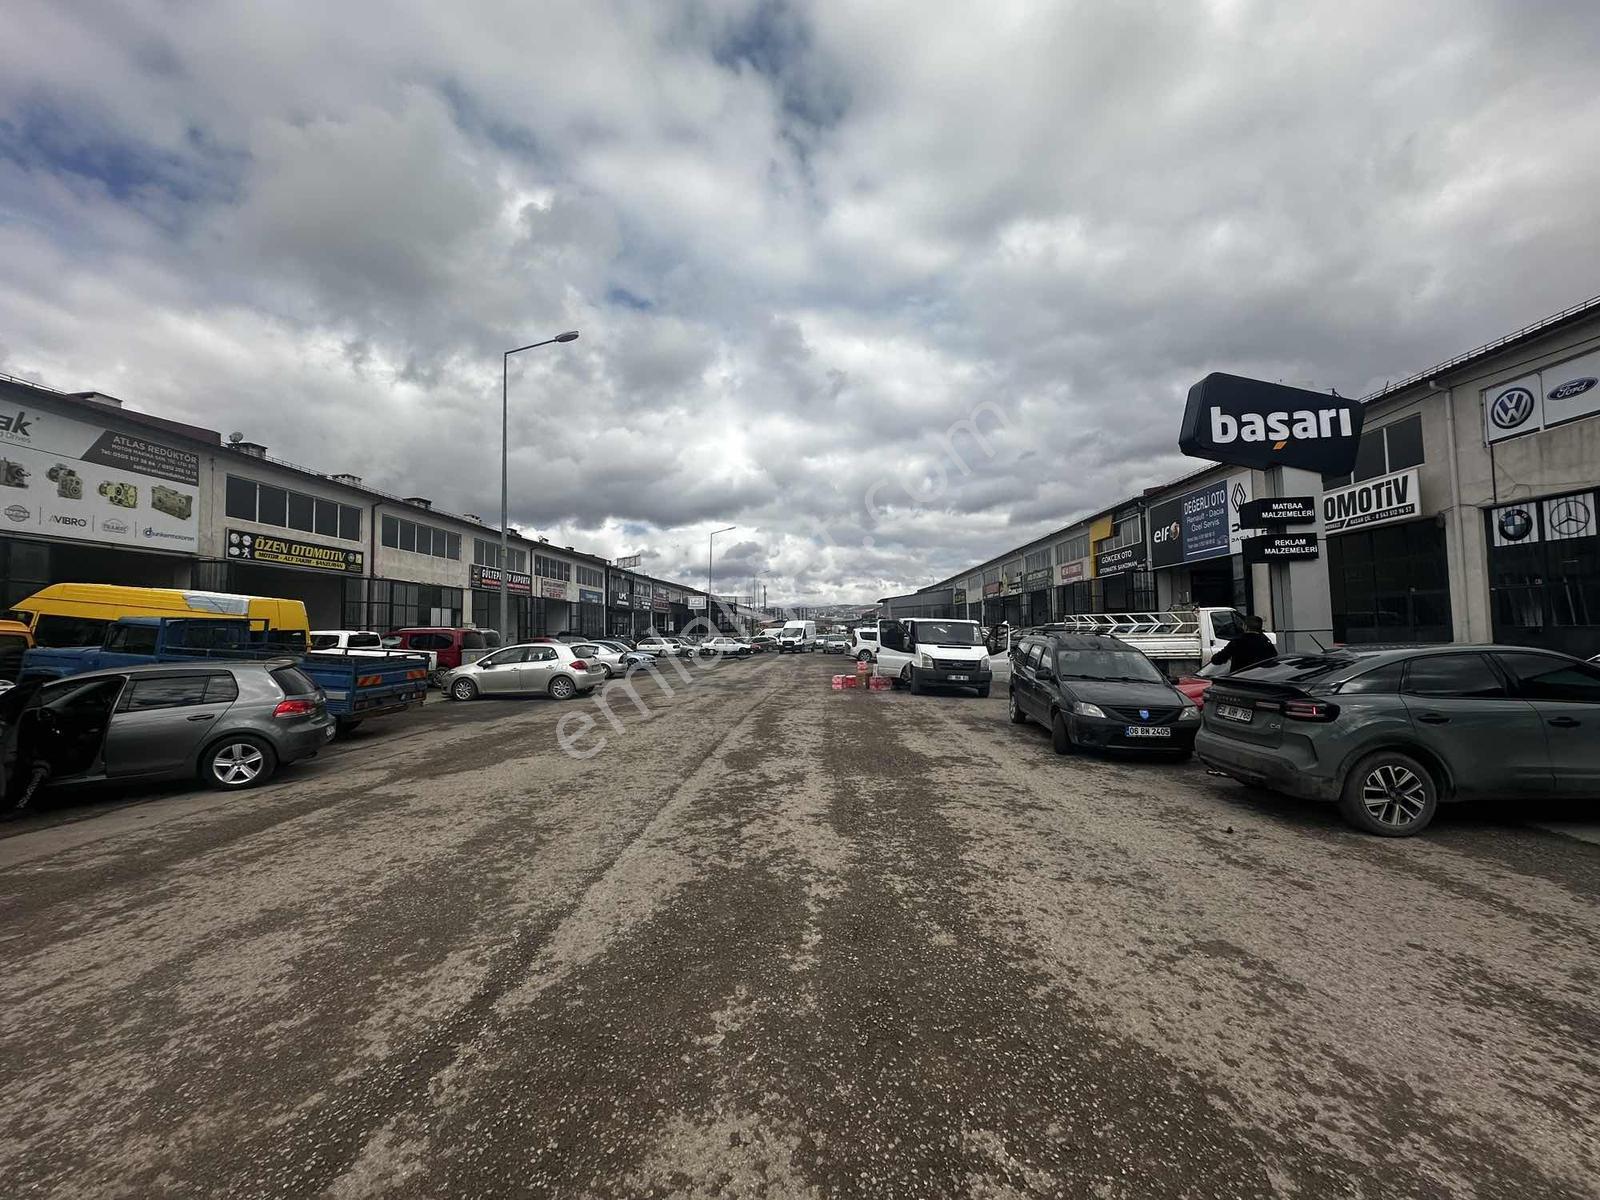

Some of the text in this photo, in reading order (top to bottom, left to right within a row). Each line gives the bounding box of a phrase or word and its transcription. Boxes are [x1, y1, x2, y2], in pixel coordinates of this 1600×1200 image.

[1556, 380, 1588, 399] Ford
[1209, 405, 1353, 450] başarı
[112, 435, 146, 450] ATLAS
[1210, 489, 1225, 507] OTO
[1272, 502, 1303, 510] MATBAA
[1208, 507, 1224, 518] Dacia
[1261, 508, 1314, 518] MALZEMELERİ
[1203, 519, 1220, 529] Servis
[1153, 525, 1170, 543] elf
[254, 536, 289, 554] ÖZEN
[1274, 538, 1306, 547] REKLAM
[1121, 550, 1132, 559] OTO
[1264, 544, 1318, 555] MALZEMELERİ
[1129, 726, 1170, 736] 06 BN 2405
